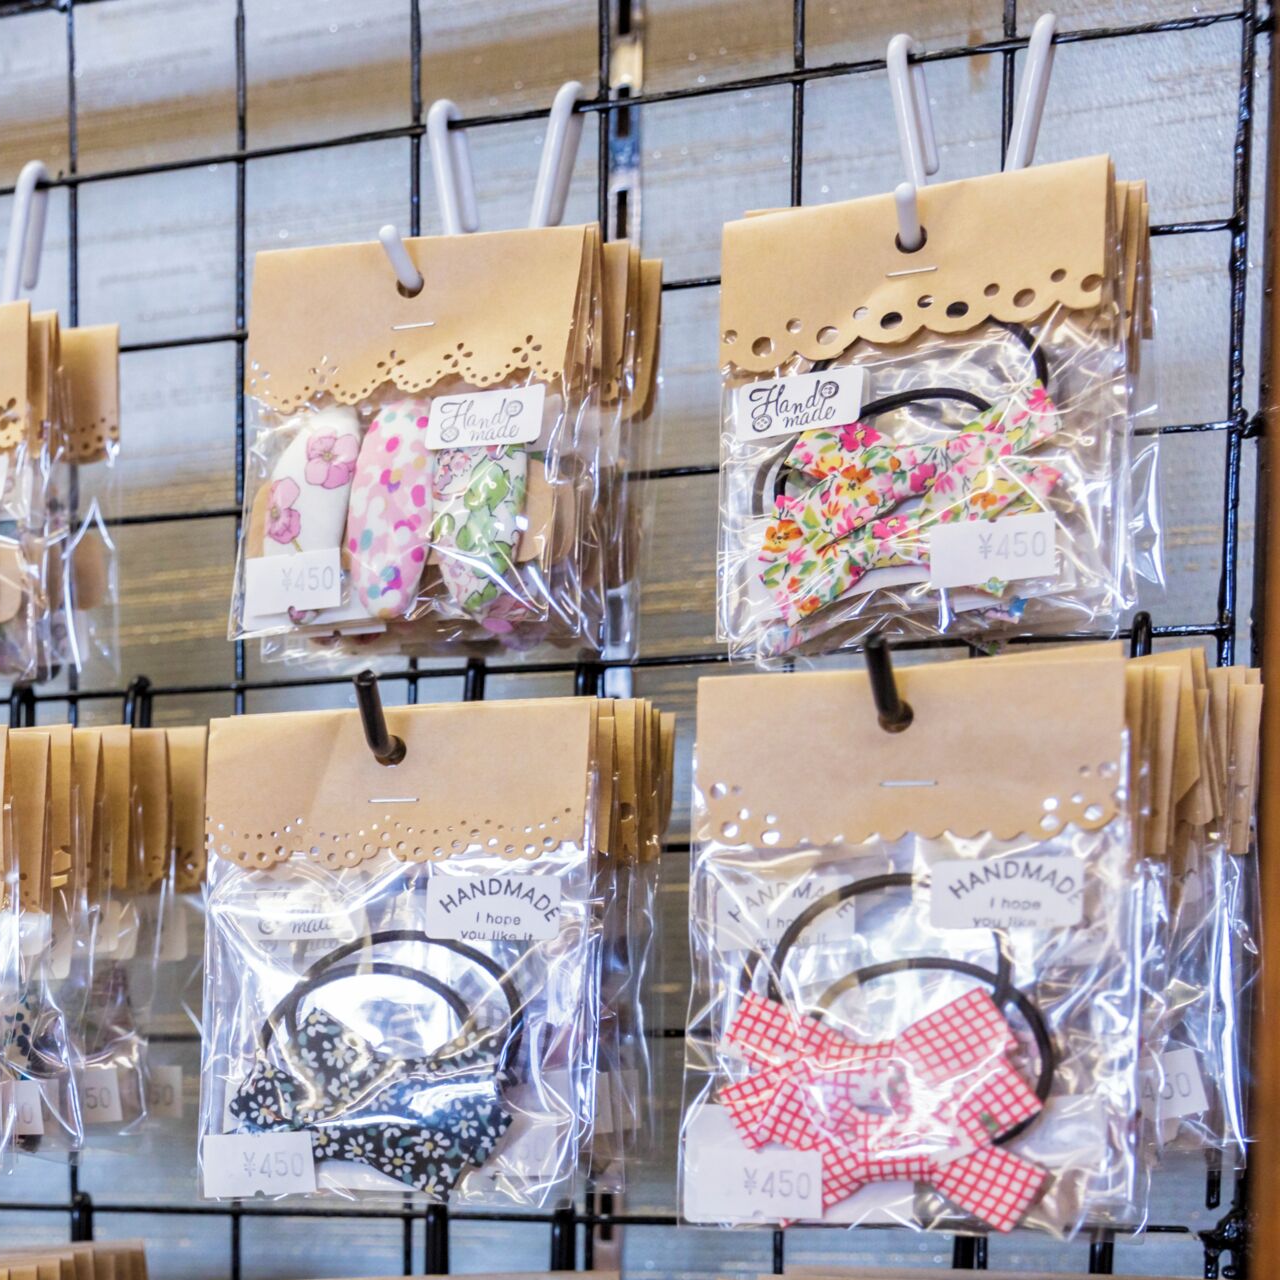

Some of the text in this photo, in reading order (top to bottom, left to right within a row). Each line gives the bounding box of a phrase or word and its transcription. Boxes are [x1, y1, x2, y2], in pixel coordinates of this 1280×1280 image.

[749, 379, 821, 418] Hand
[440, 398, 506, 430] Hand
[784, 404, 836, 429] made
[471, 422, 519, 441] made
[978, 531, 1047, 561] ¥450
[281, 566, 334, 592] ¥450
[949, 860, 1083, 904] HANDMADE
[439, 878, 560, 923] HANDMADE
[728, 882, 855, 922] HANMAE
[1000, 898, 1041, 911] hope
[486, 914, 521, 926] hope
[243, 1150, 304, 1178] ¥450
[744, 1167, 811, 1200] ¥450
